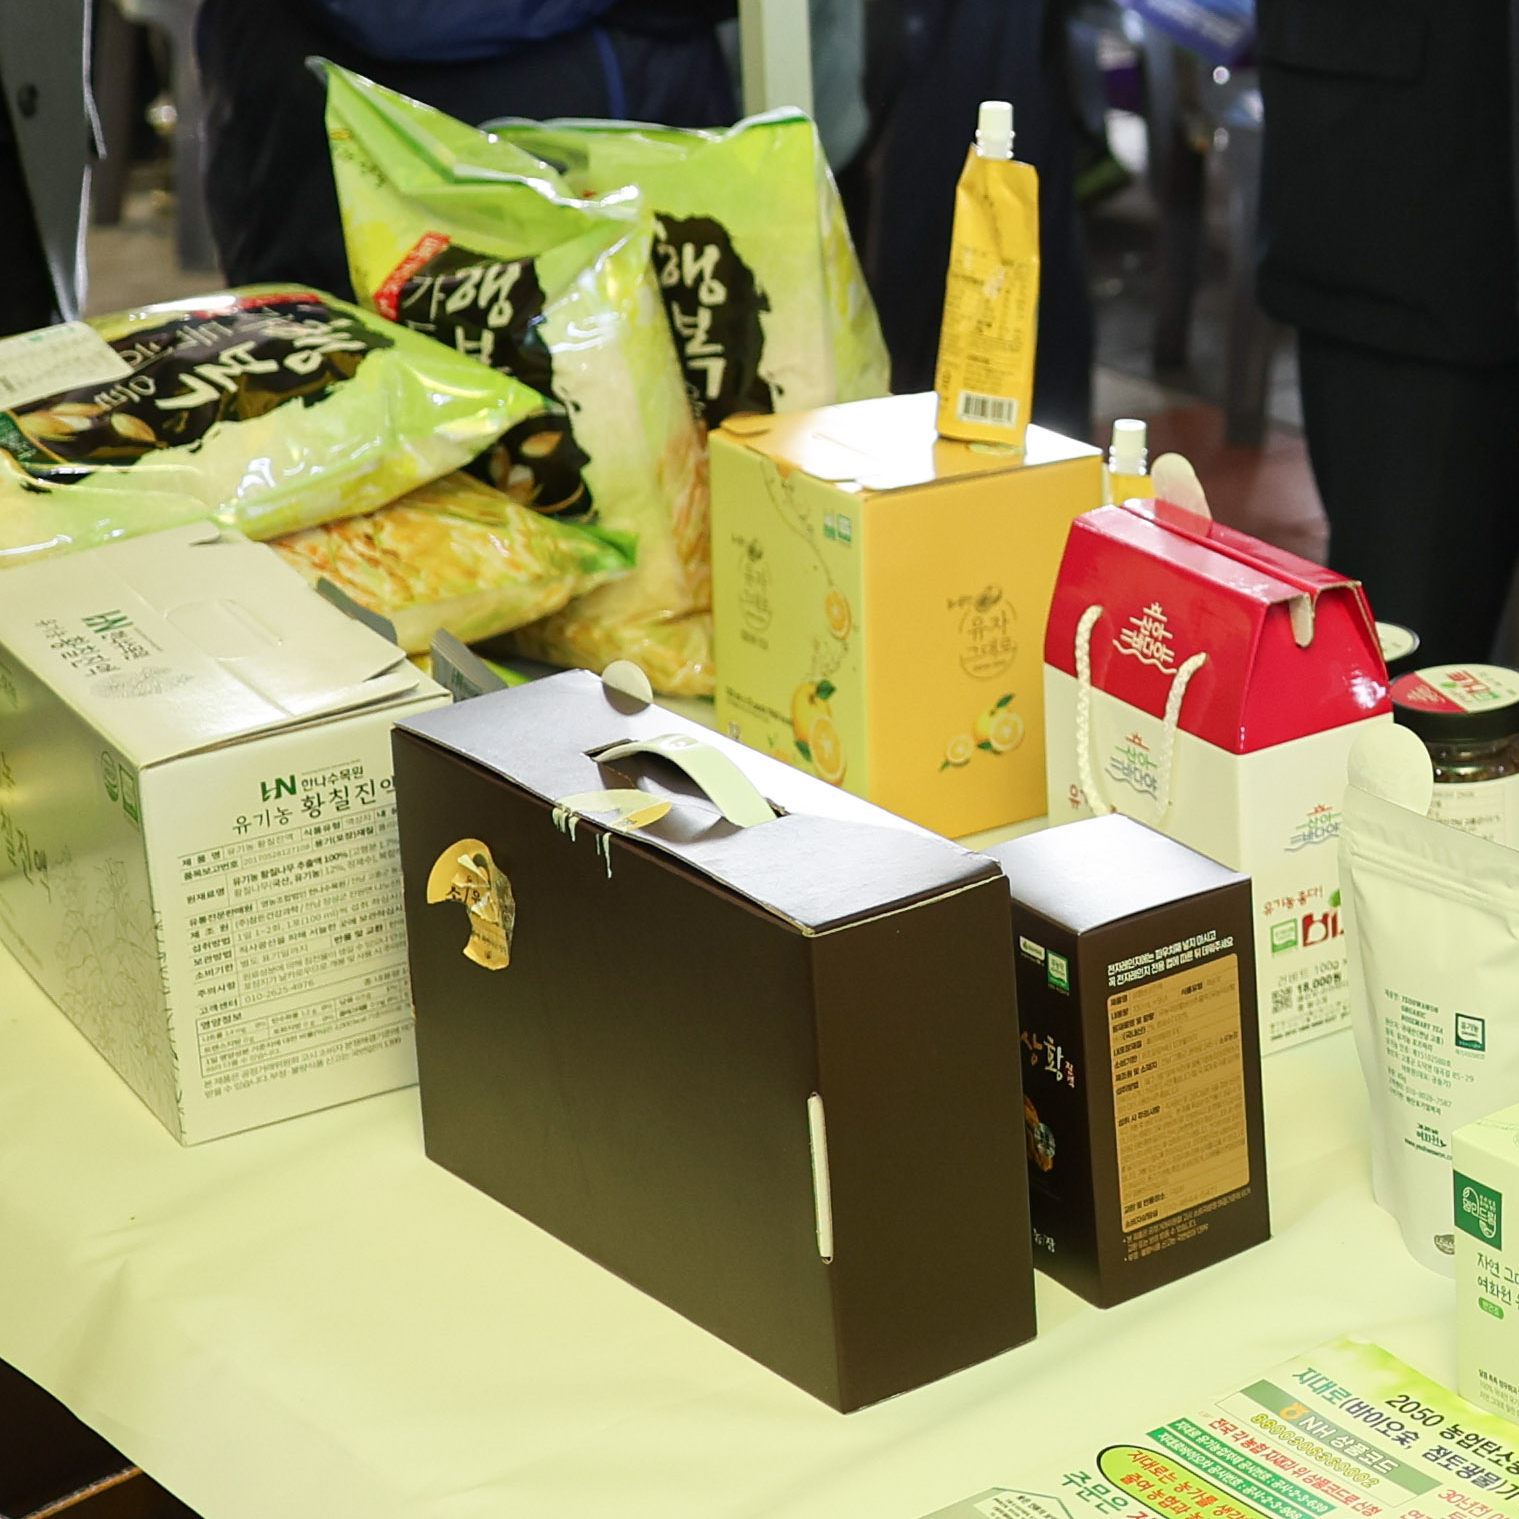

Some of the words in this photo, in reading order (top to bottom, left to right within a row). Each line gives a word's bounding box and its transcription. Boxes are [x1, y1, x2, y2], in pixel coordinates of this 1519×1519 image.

[231, 802, 293, 837] 유기농
[1477, 1252, 1501, 1278] 자연
[1477, 1275, 1512, 1306] 여화원
[1384, 1393, 1446, 1429] 2050
[1300, 1415, 1338, 1440] NH
[1335, 1434, 1401, 1474] 상품코드
[1127, 1449, 1179, 1486] 지대로는
[1209, 1417, 1238, 1436] 전국
[1302, 1470, 1359, 1509] 상품코드로
[1062, 1469, 1129, 1515] 주문은
